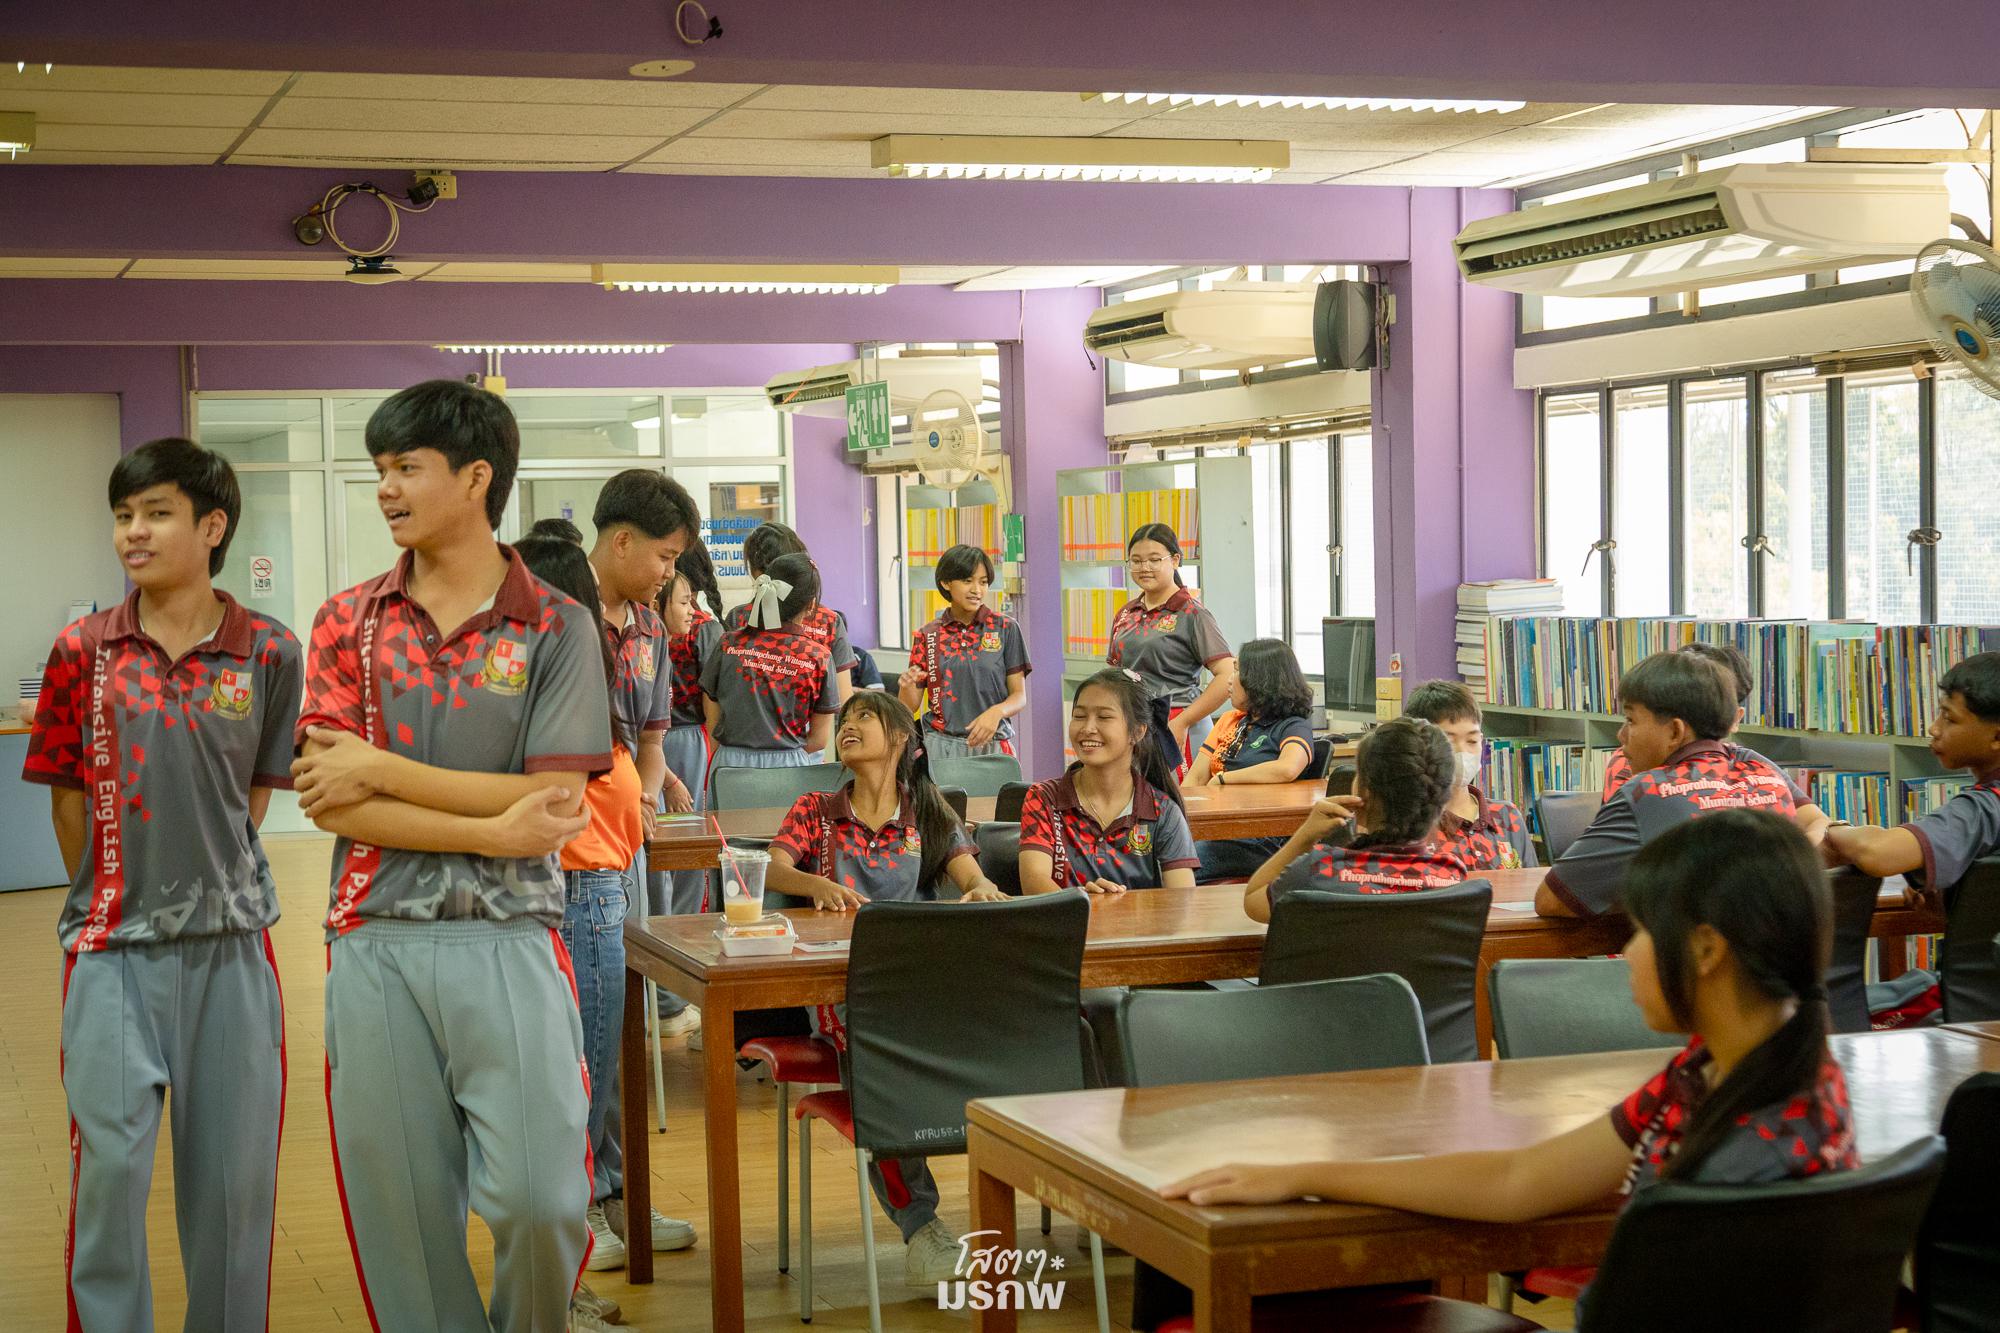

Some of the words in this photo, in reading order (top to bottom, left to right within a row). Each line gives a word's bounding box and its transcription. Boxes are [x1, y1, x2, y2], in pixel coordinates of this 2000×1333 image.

[743, 659, 774, 673] Municipal
[775, 665, 799, 677] School
[928, 632, 937, 683] Intensive
[94, 646, 112, 767] Intensive
[1698, 793, 1746, 810] Municipal
[1746, 790, 1778, 806] School
[96, 780, 120, 875] English
